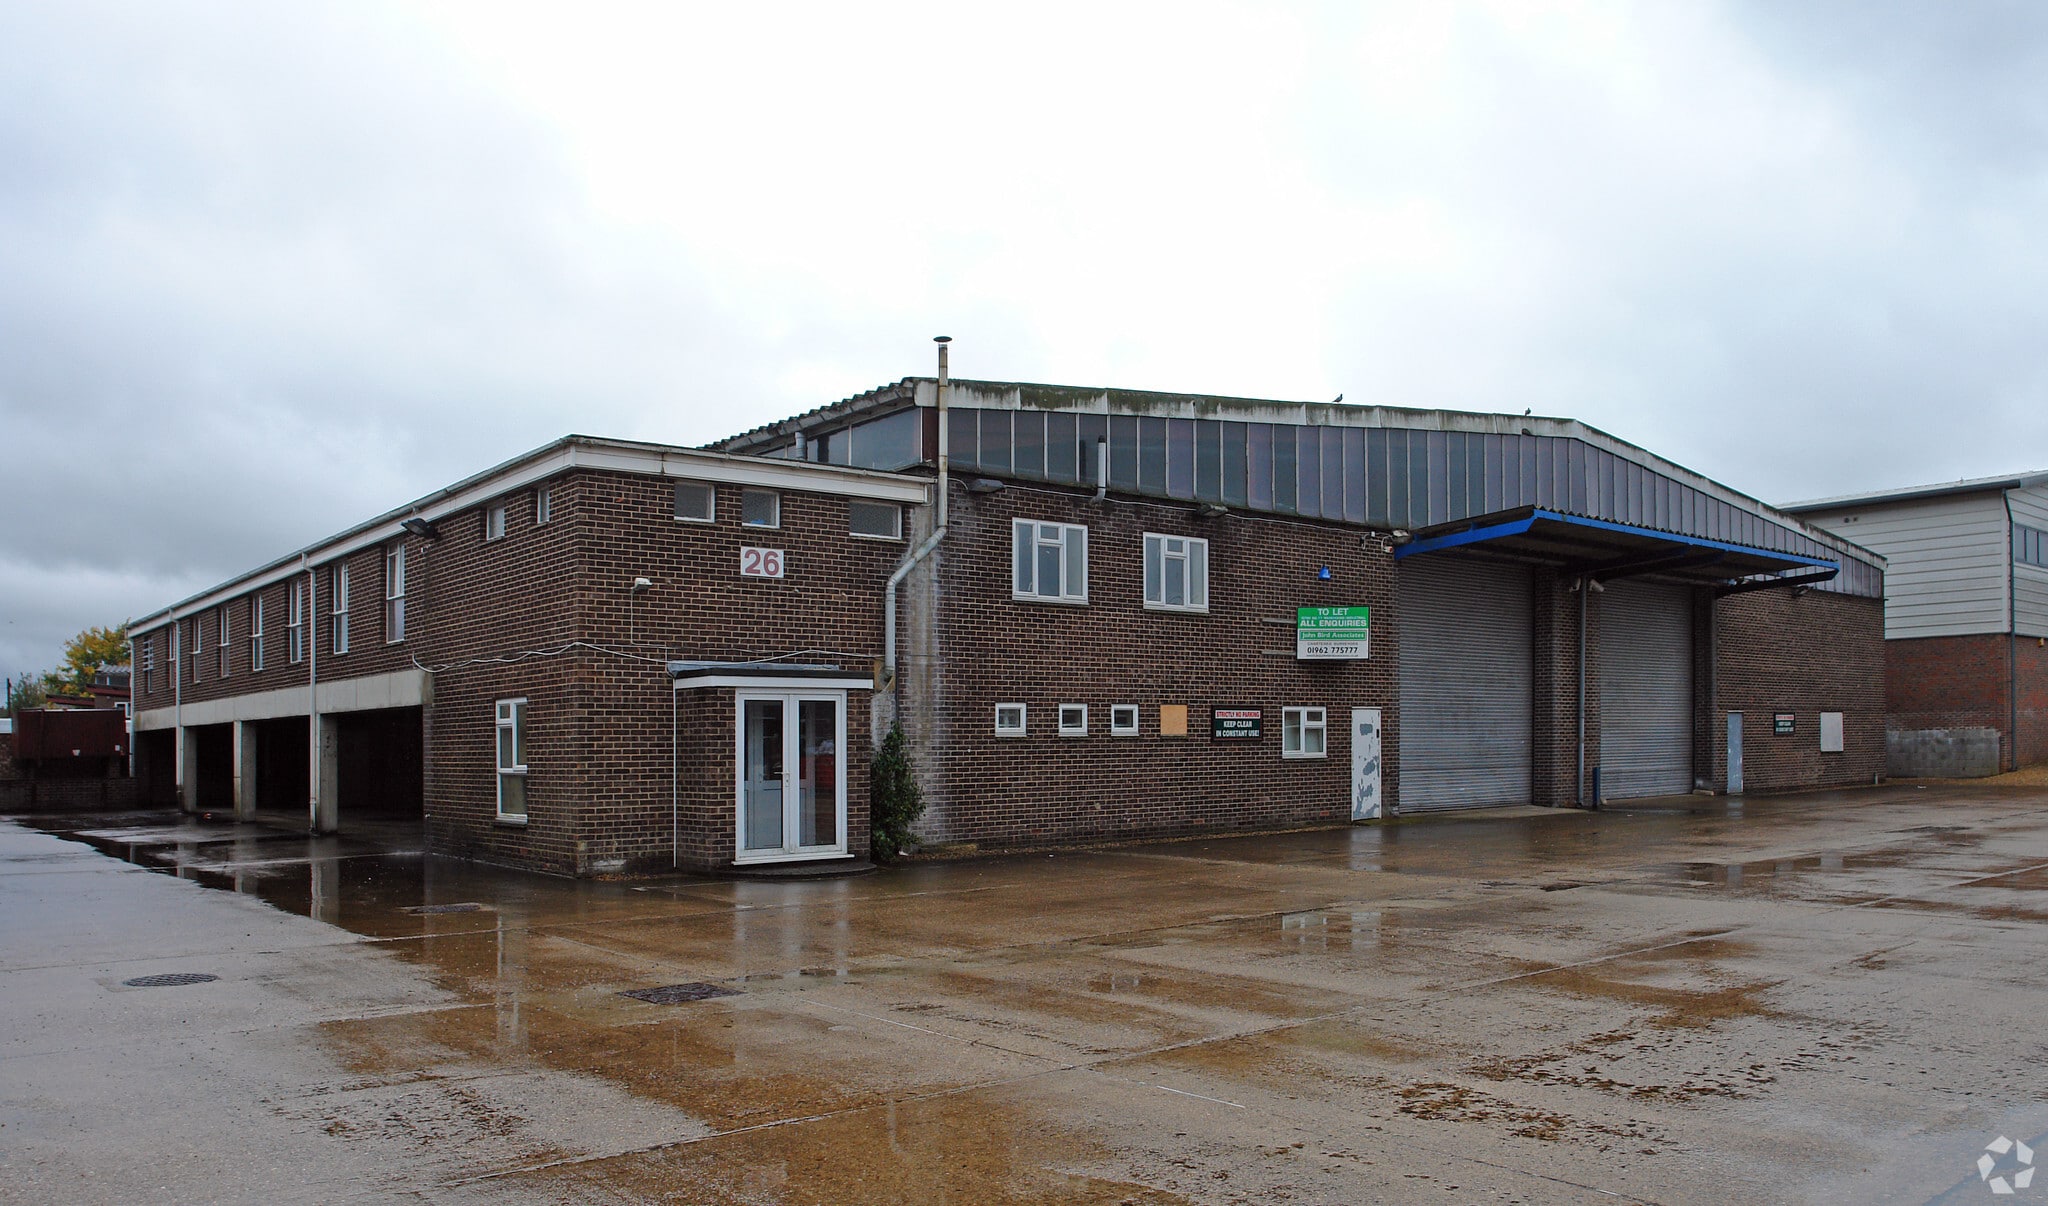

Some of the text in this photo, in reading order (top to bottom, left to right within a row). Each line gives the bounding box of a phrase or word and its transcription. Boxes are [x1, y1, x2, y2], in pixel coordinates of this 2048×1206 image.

[744, 549, 779, 576] 26
[1317, 608, 1349, 616] TO LET
[1300, 619, 1366, 627] ALL ENQUIRIES
[1307, 646, 1358, 654] 01962 775777
[1223, 720, 1253, 728] KEEP CLEAR
[1215, 729, 1260, 737] IN CONSTANT USE!
